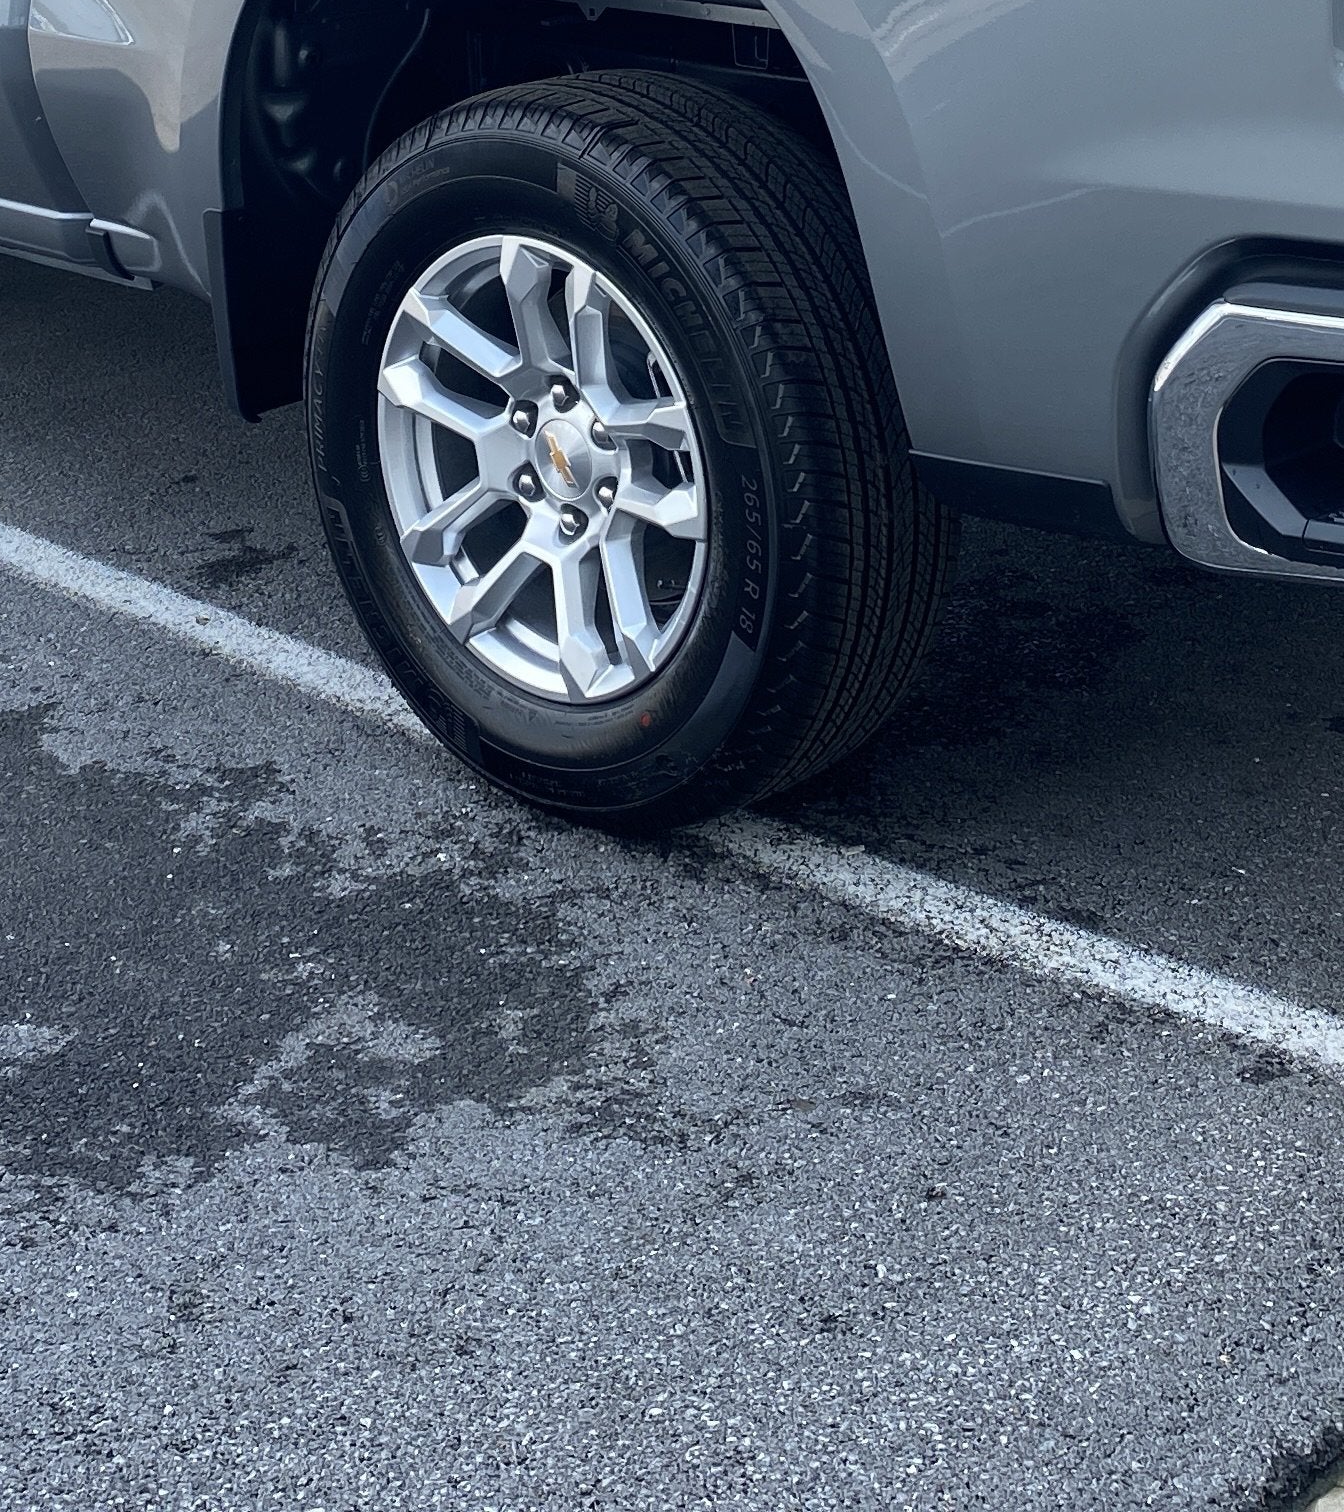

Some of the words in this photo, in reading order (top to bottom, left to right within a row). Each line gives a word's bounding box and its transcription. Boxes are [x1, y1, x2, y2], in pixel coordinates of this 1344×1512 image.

[621, 228, 746, 427] MICHELIN
[742, 474, 762, 575] 265/65
[739, 606, 756, 634] 18
[744, 577, 760, 600] R
